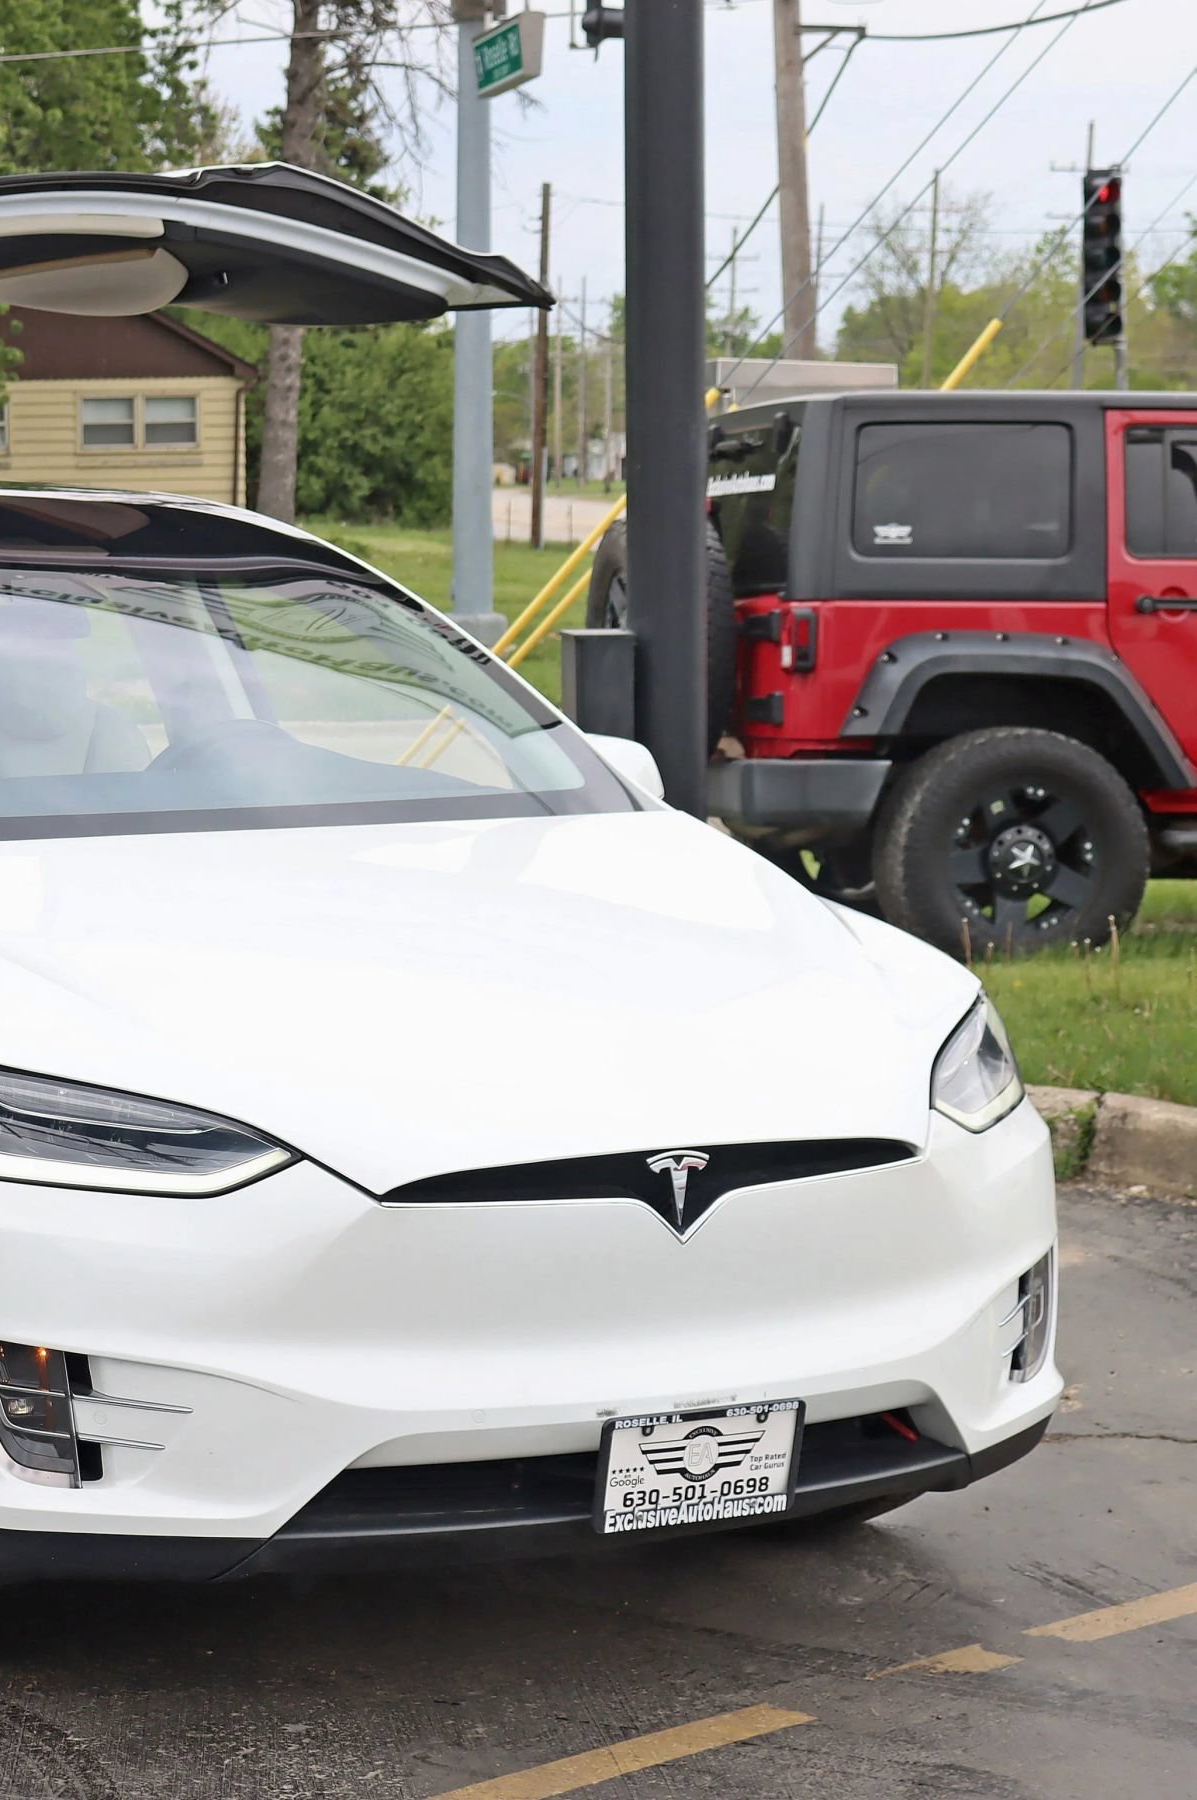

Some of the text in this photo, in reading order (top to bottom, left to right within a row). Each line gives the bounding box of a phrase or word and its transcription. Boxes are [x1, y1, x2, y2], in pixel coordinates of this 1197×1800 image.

[726, 1401, 799, 1417] 630-501-0698
[615, 1414, 683, 1429] ROSELLE, IL
[688, 1442, 713, 1467] EA
[750, 1451, 786, 1463] Top Rated
[750, 1461, 785, 1471] Car Gurus
[610, 1475, 645, 1488] Google
[622, 1476, 770, 1508] 630-501-0698
[604, 1493, 788, 1534] ExclusiveAutoHaus.com
